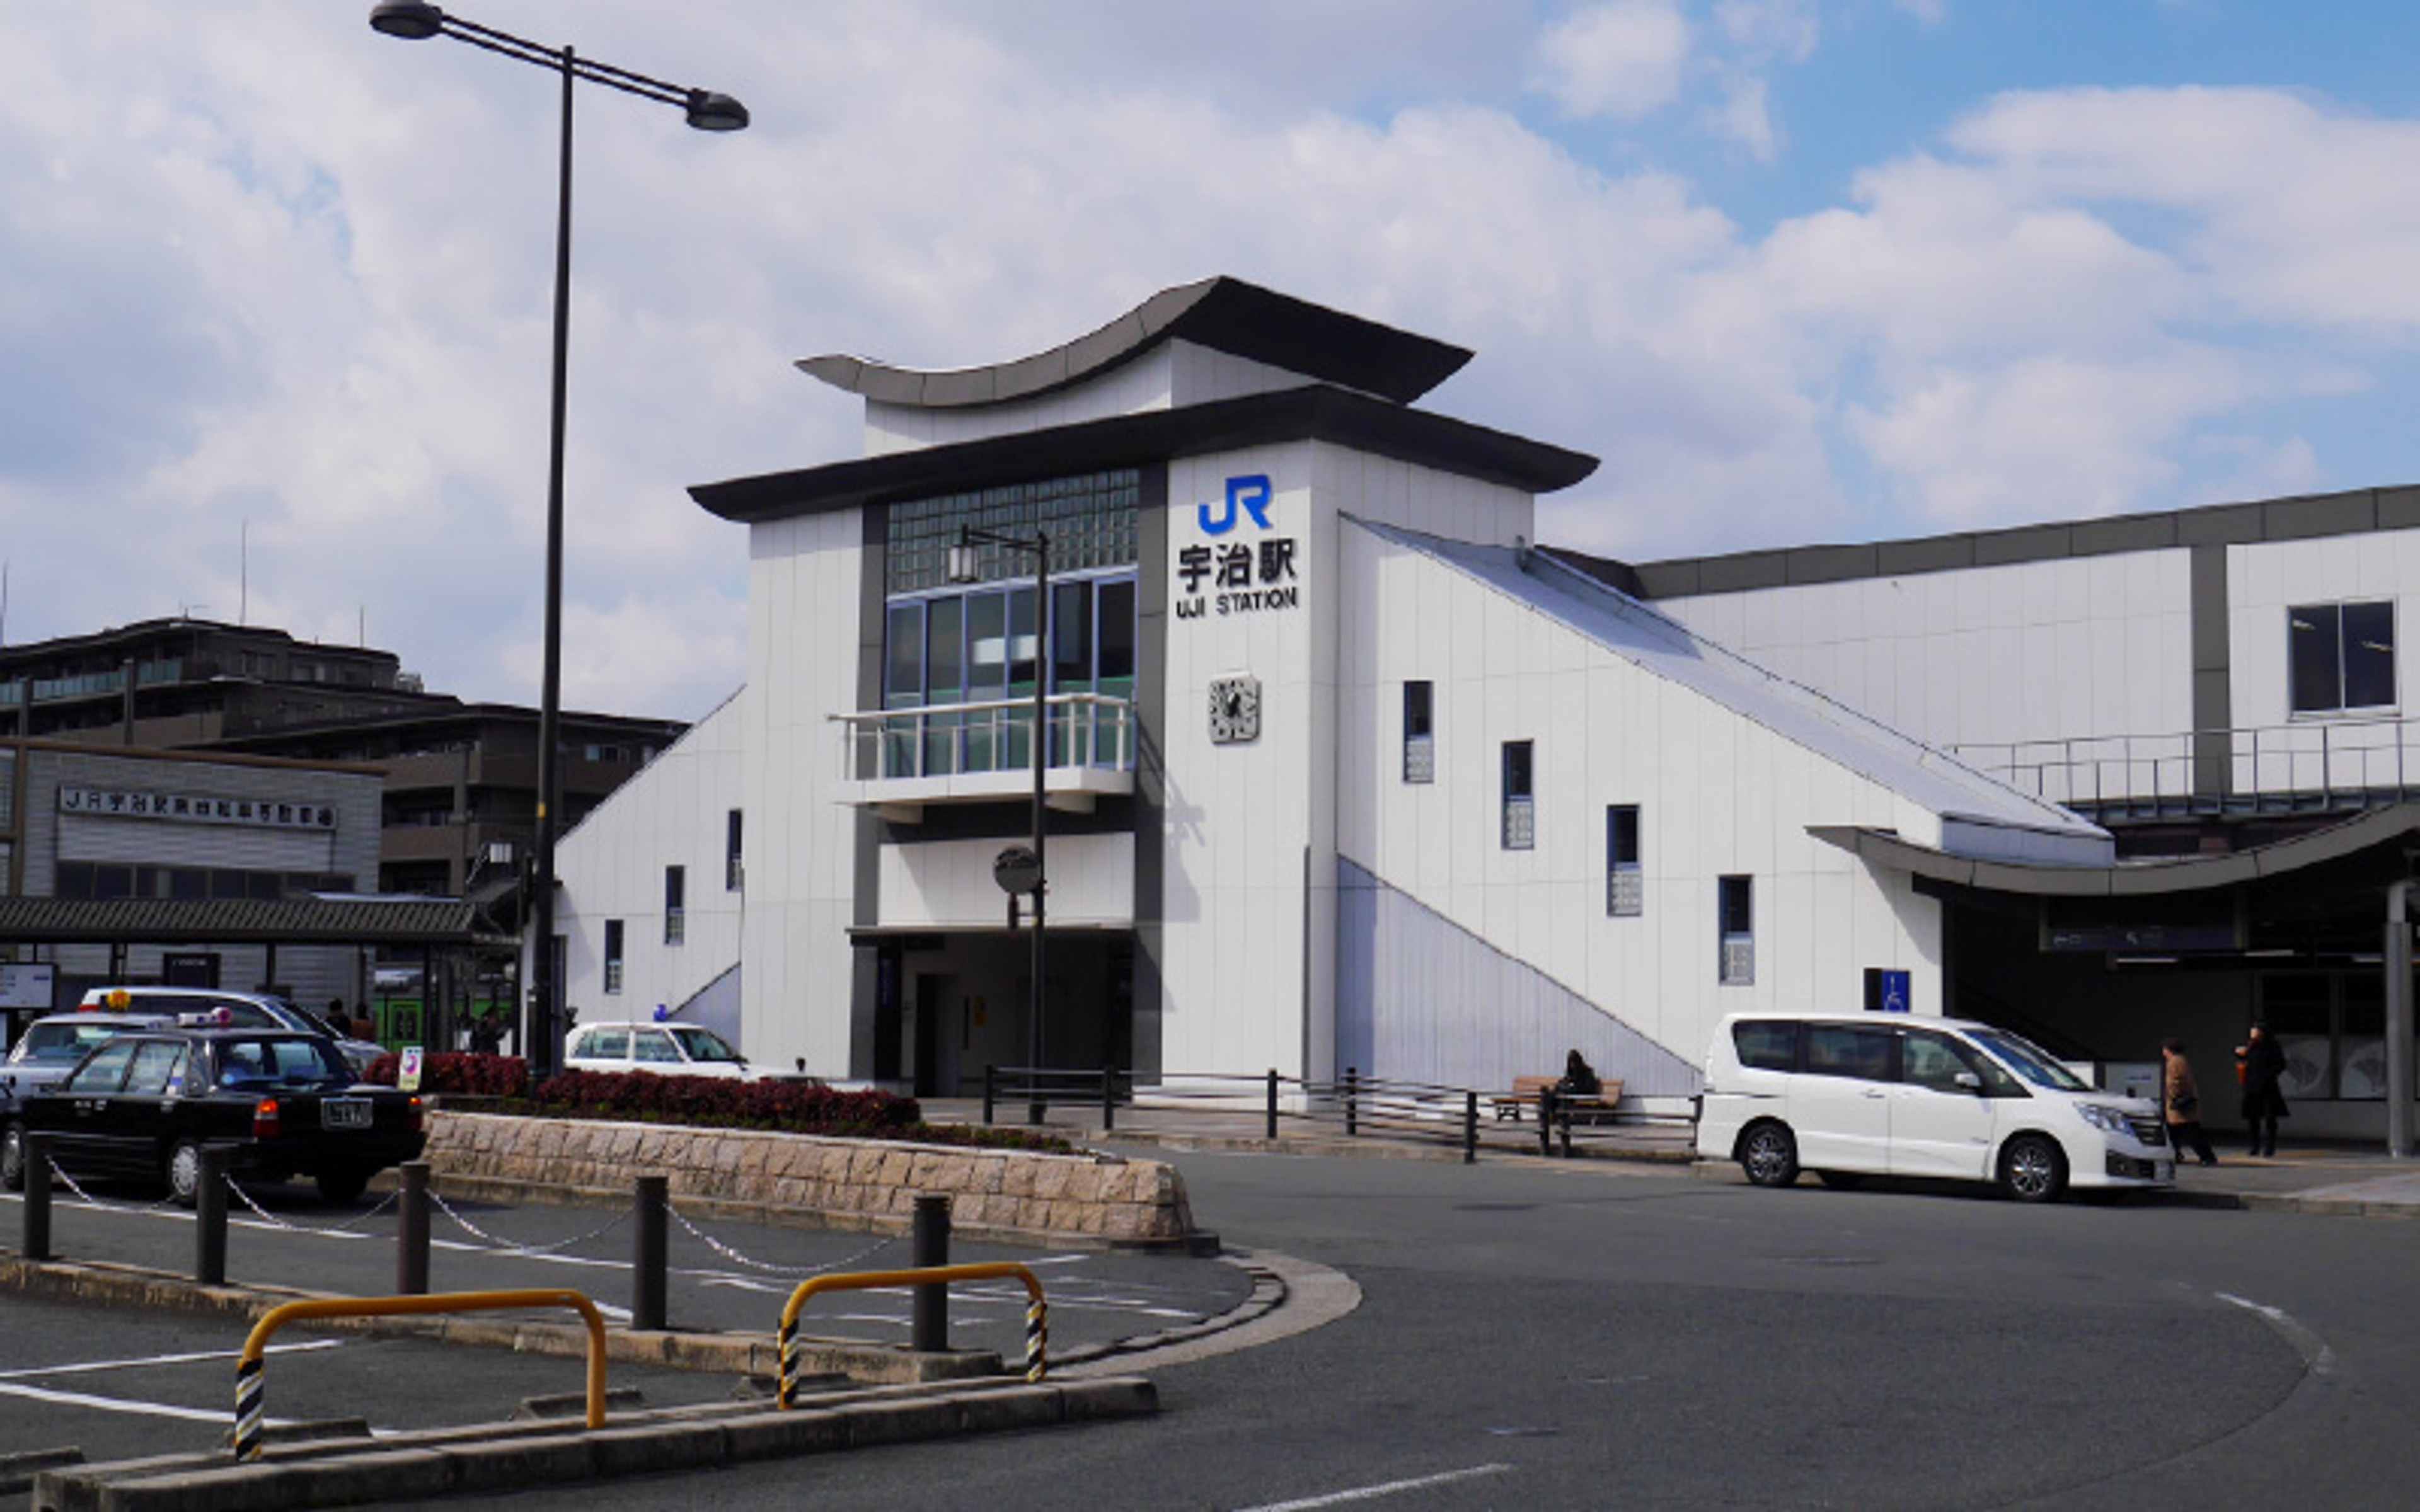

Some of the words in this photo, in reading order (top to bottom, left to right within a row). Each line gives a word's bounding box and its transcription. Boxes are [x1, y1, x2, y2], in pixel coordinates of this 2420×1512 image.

[1199, 474, 1271, 535] JR
[1178, 539, 1296, 593] 宇治駅
[1176, 597, 1205, 619] UJI
[1216, 587, 1297, 616] STATION
